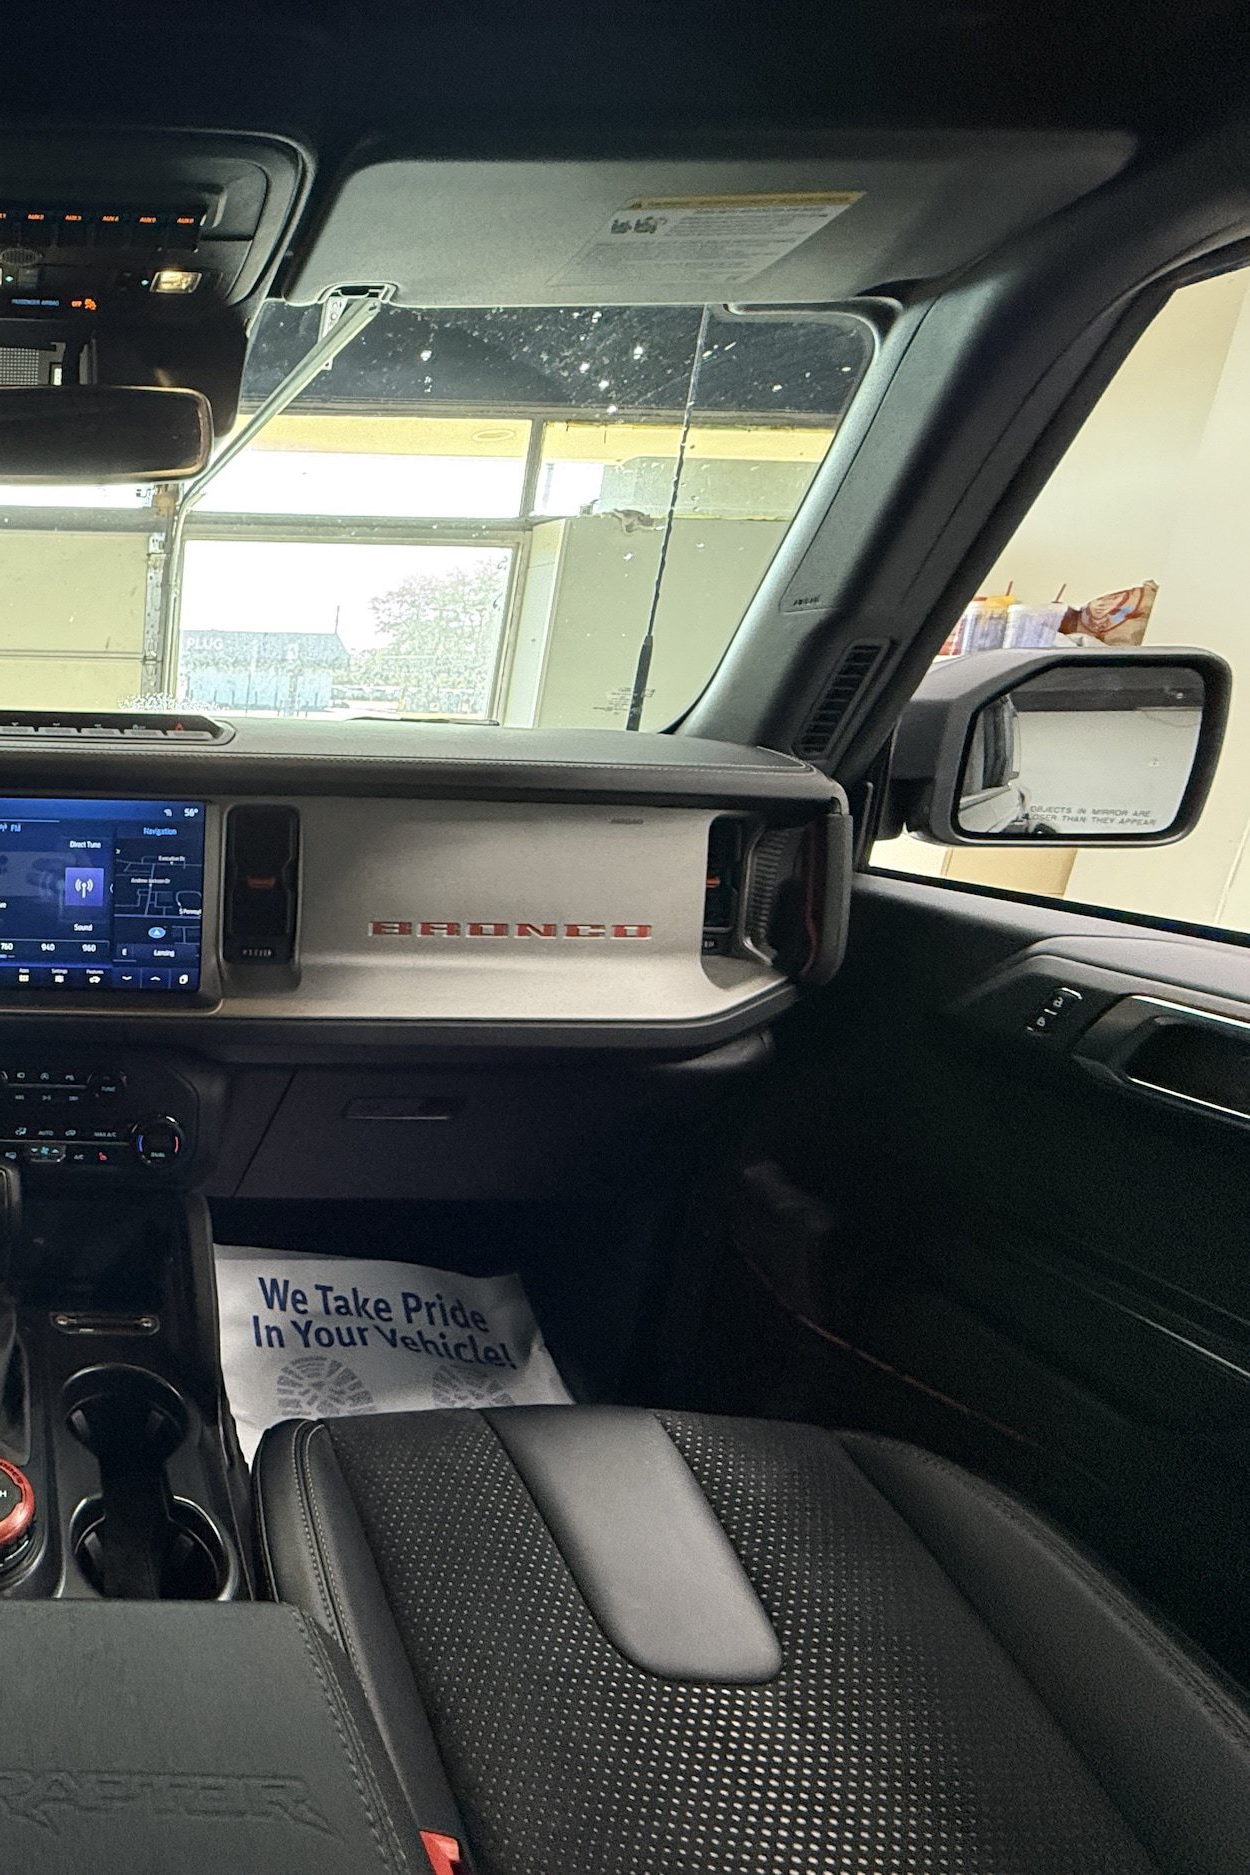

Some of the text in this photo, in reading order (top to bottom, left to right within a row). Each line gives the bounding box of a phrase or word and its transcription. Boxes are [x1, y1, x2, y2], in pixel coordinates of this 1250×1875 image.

[1030, 805, 1071, 814] OBJECTS
[1077, 807, 1087, 815] IN
[1092, 808, 1128, 816] MIRROR
[1062, 815, 1086, 823] THAN
[1091, 816, 1114, 824] THEY
[1118, 818, 1156, 826] APPEAR
[143, 827, 178, 836] Navigation
[73, 923, 93, 931] Sound
[368, 921, 652, 940] BRONCO
[258, 1276, 490, 1333] We Take Pride
[252, 1315, 518, 1371] In Your Vehicle!
